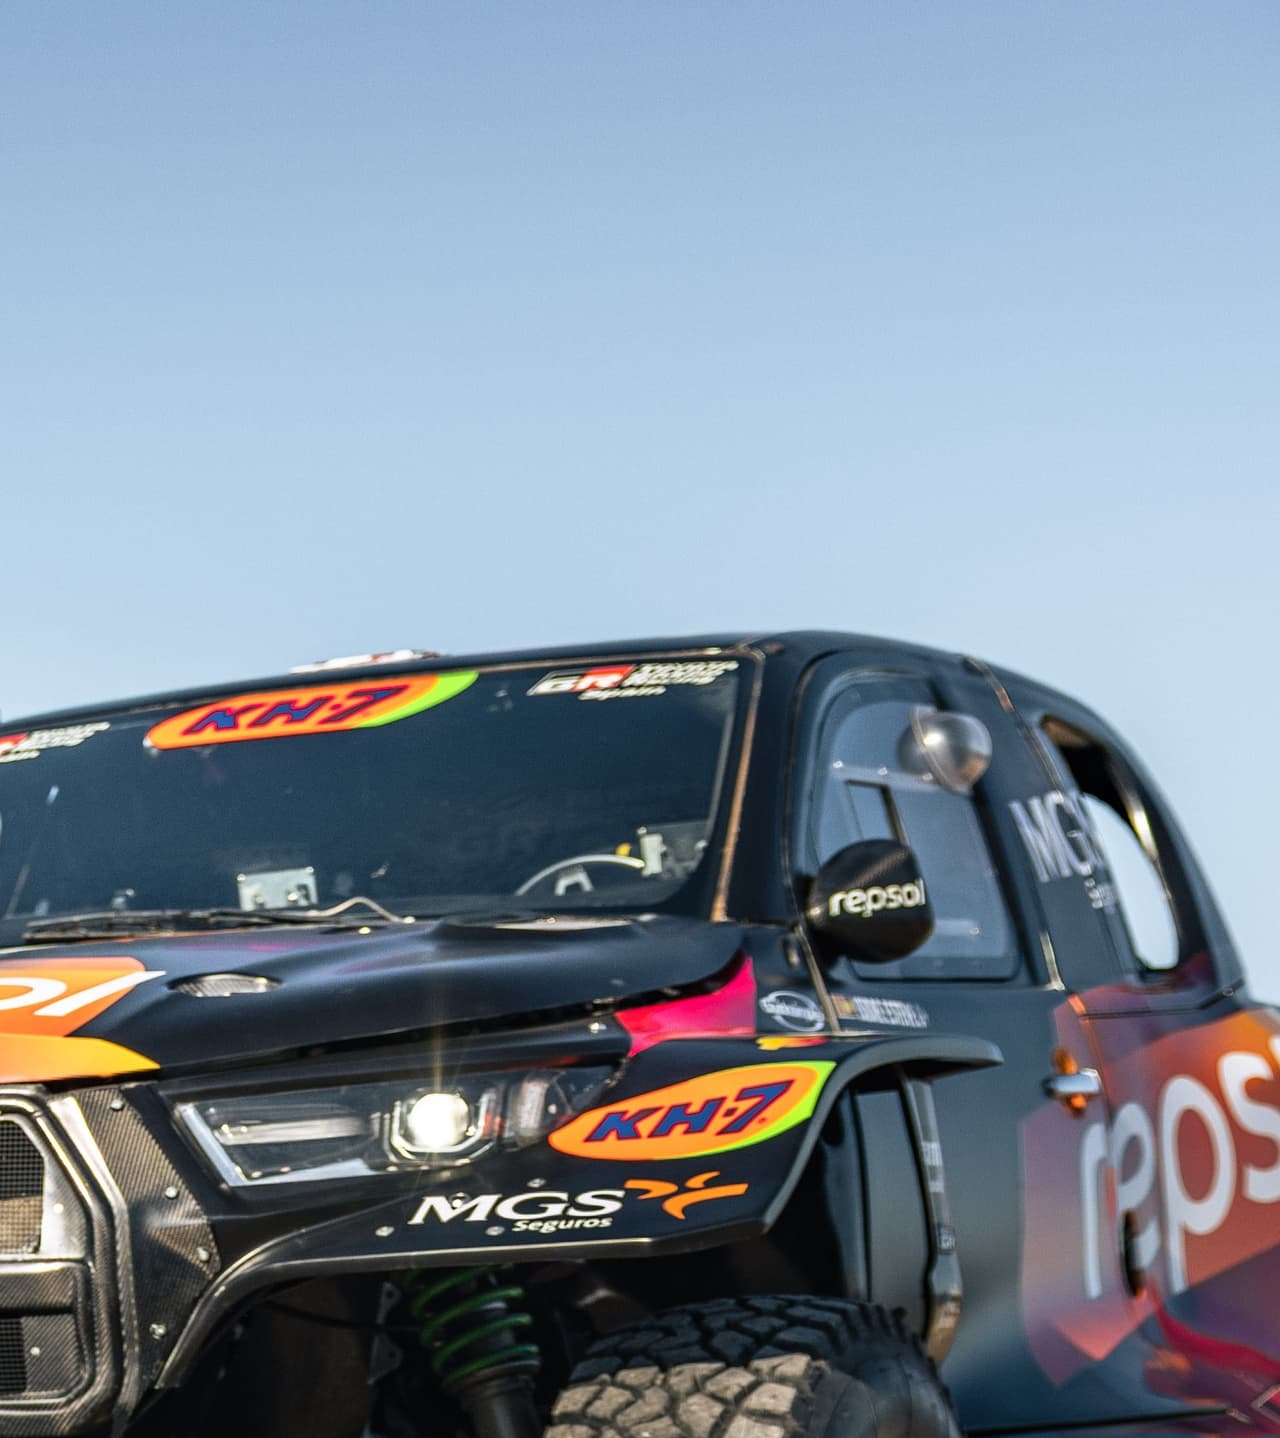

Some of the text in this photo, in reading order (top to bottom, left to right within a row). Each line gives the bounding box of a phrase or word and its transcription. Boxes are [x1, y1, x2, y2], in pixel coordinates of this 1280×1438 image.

[828, 878, 926, 918] repsol
[1081, 1034, 1280, 1301] reps
[407, 1189, 627, 1226] MGS
[511, 1216, 613, 1234] Seguros
